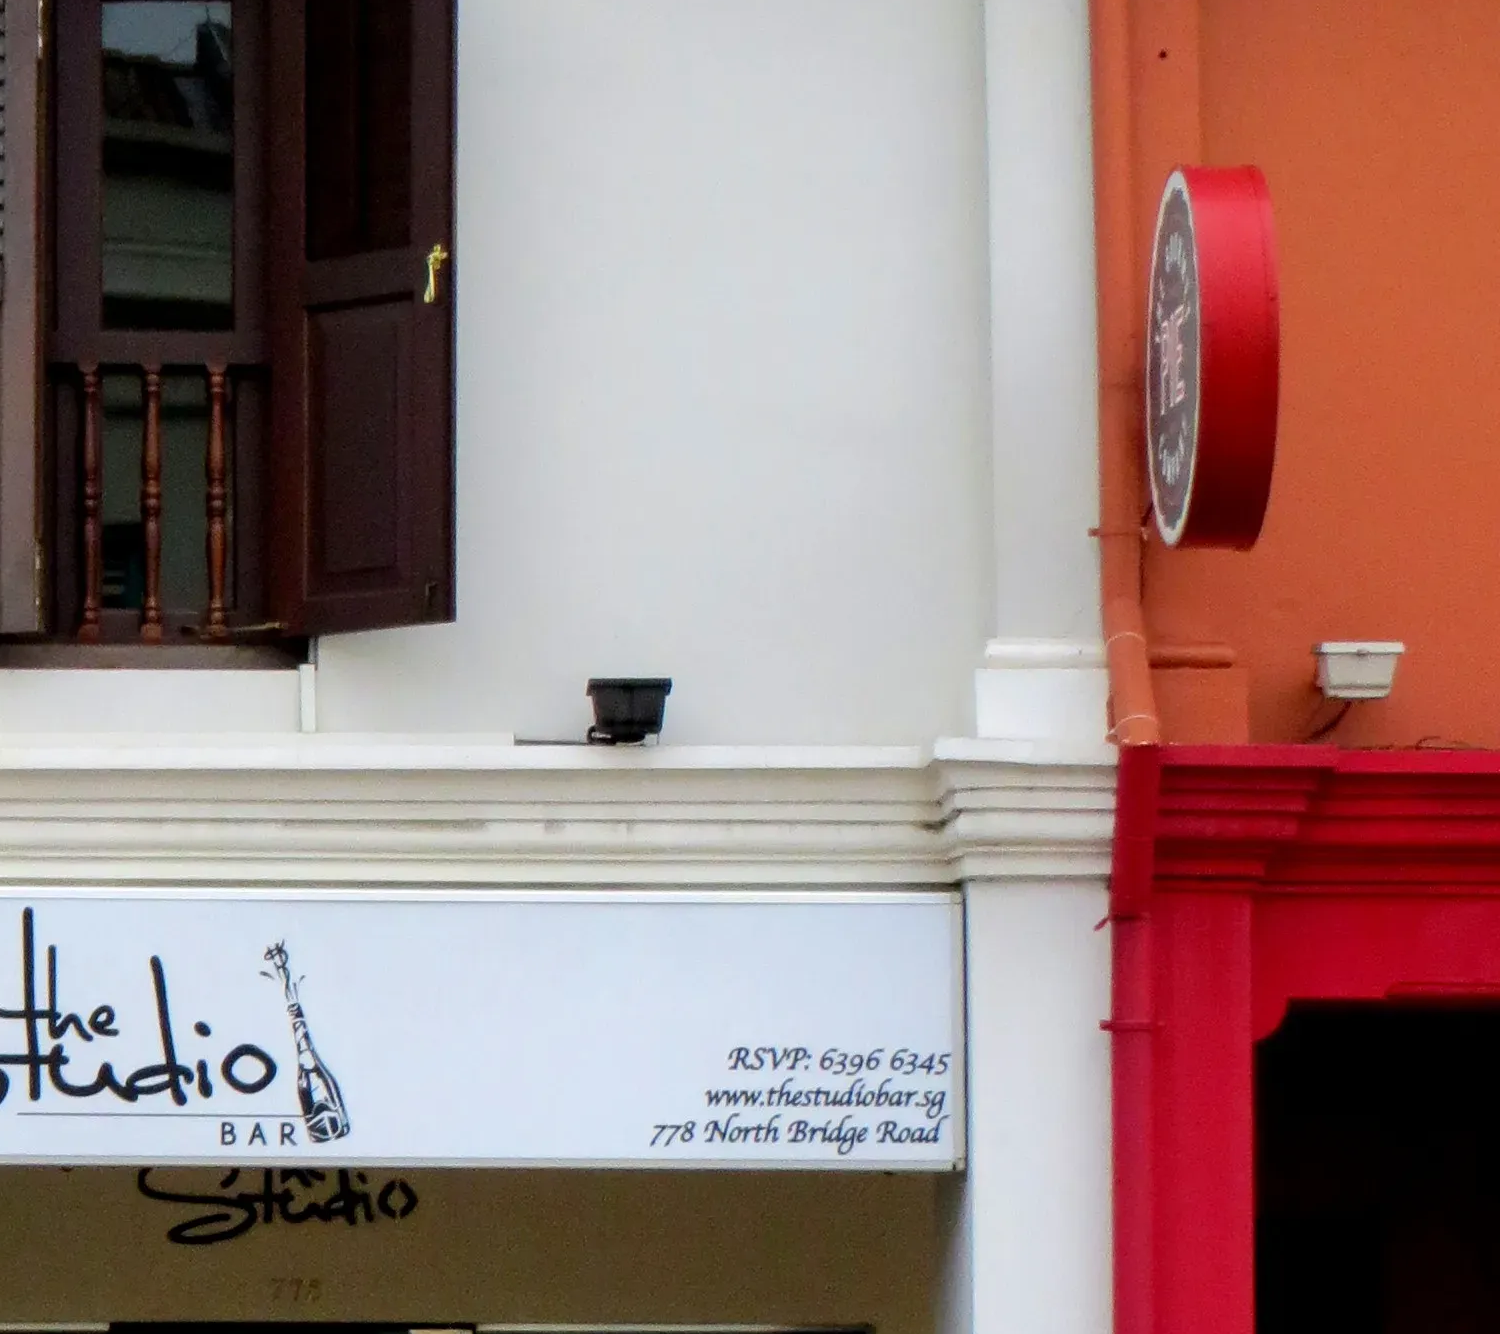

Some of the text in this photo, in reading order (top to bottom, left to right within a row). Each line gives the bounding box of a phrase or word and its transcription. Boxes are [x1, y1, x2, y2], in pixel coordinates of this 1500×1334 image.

[727, 1046, 951, 1076] RSVP: 6396 6345
[704, 1078, 947, 1119] www.thestudiobar.sg
[220, 1122, 298, 1147] BAR
[649, 1112, 951, 1155] 778 North Bridge Road
